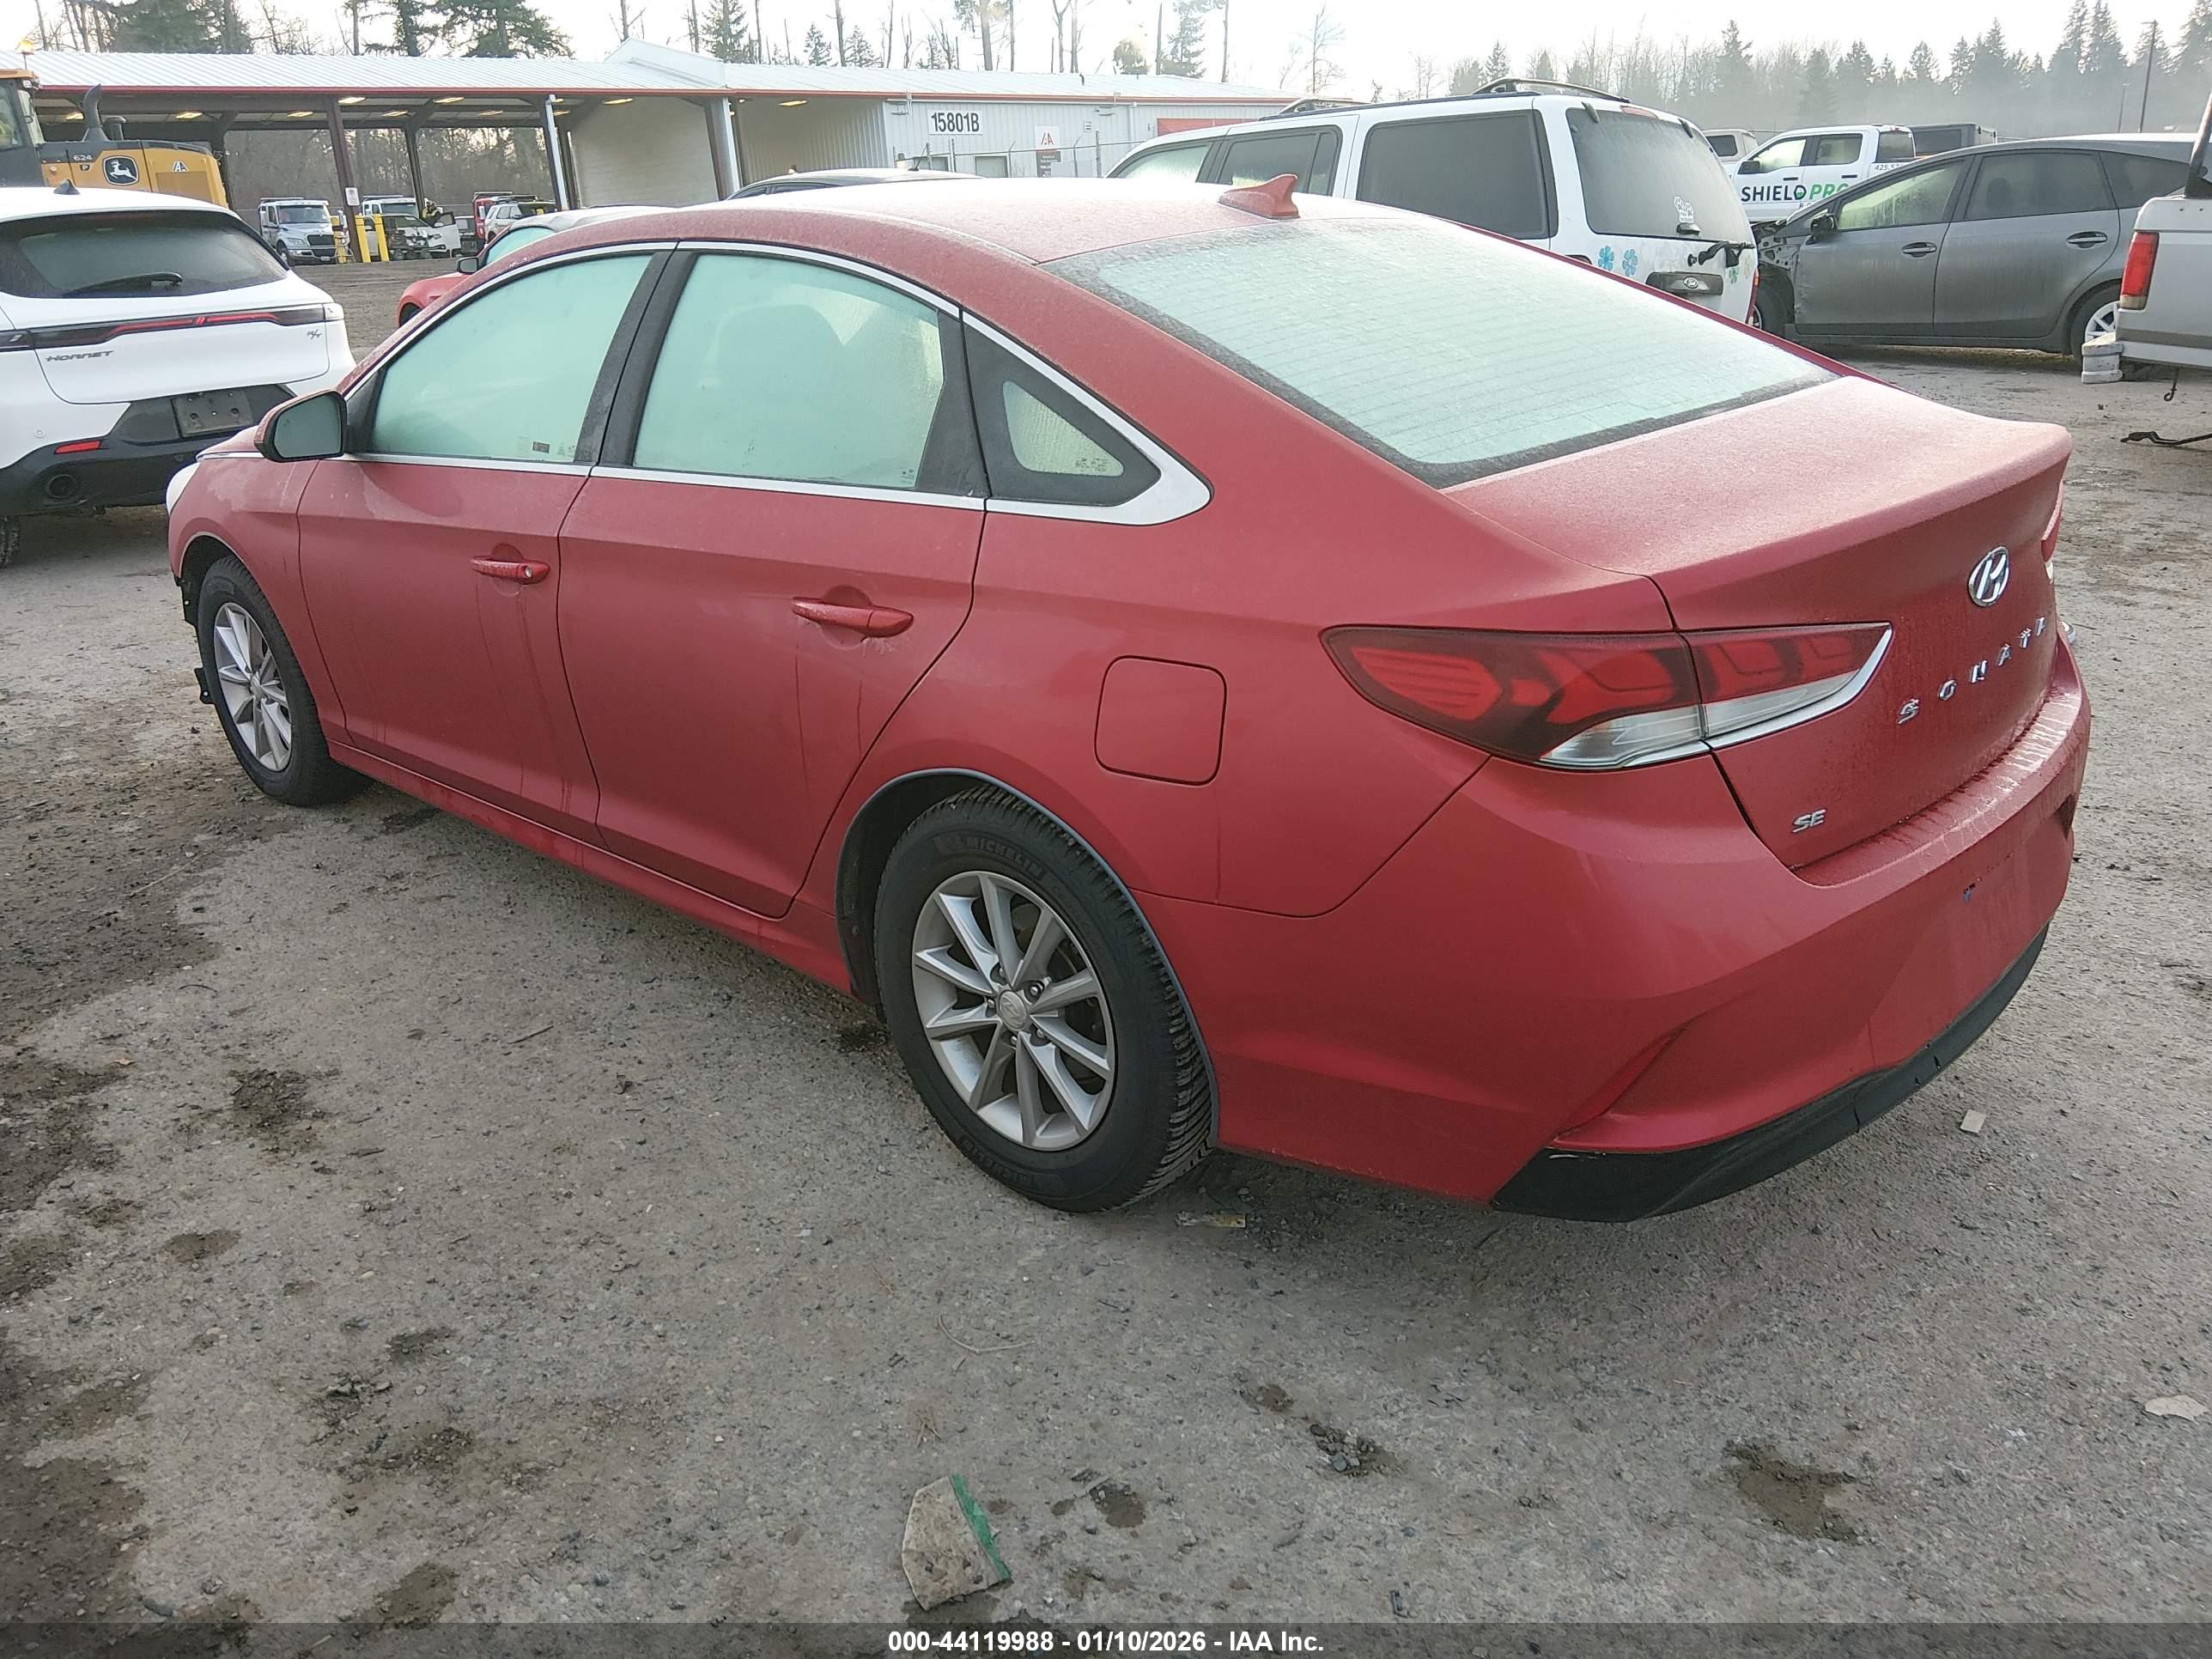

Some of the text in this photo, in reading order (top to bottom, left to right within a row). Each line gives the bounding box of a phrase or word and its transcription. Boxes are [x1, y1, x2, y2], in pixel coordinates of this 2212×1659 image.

[931, 112, 980, 132] 15801B
[1741, 185, 1807, 202] SHIELD
[46, 350, 114, 362] HORNET
[1791, 809, 1826, 833] SE
[967, 836, 1046, 880] MICHELIN
